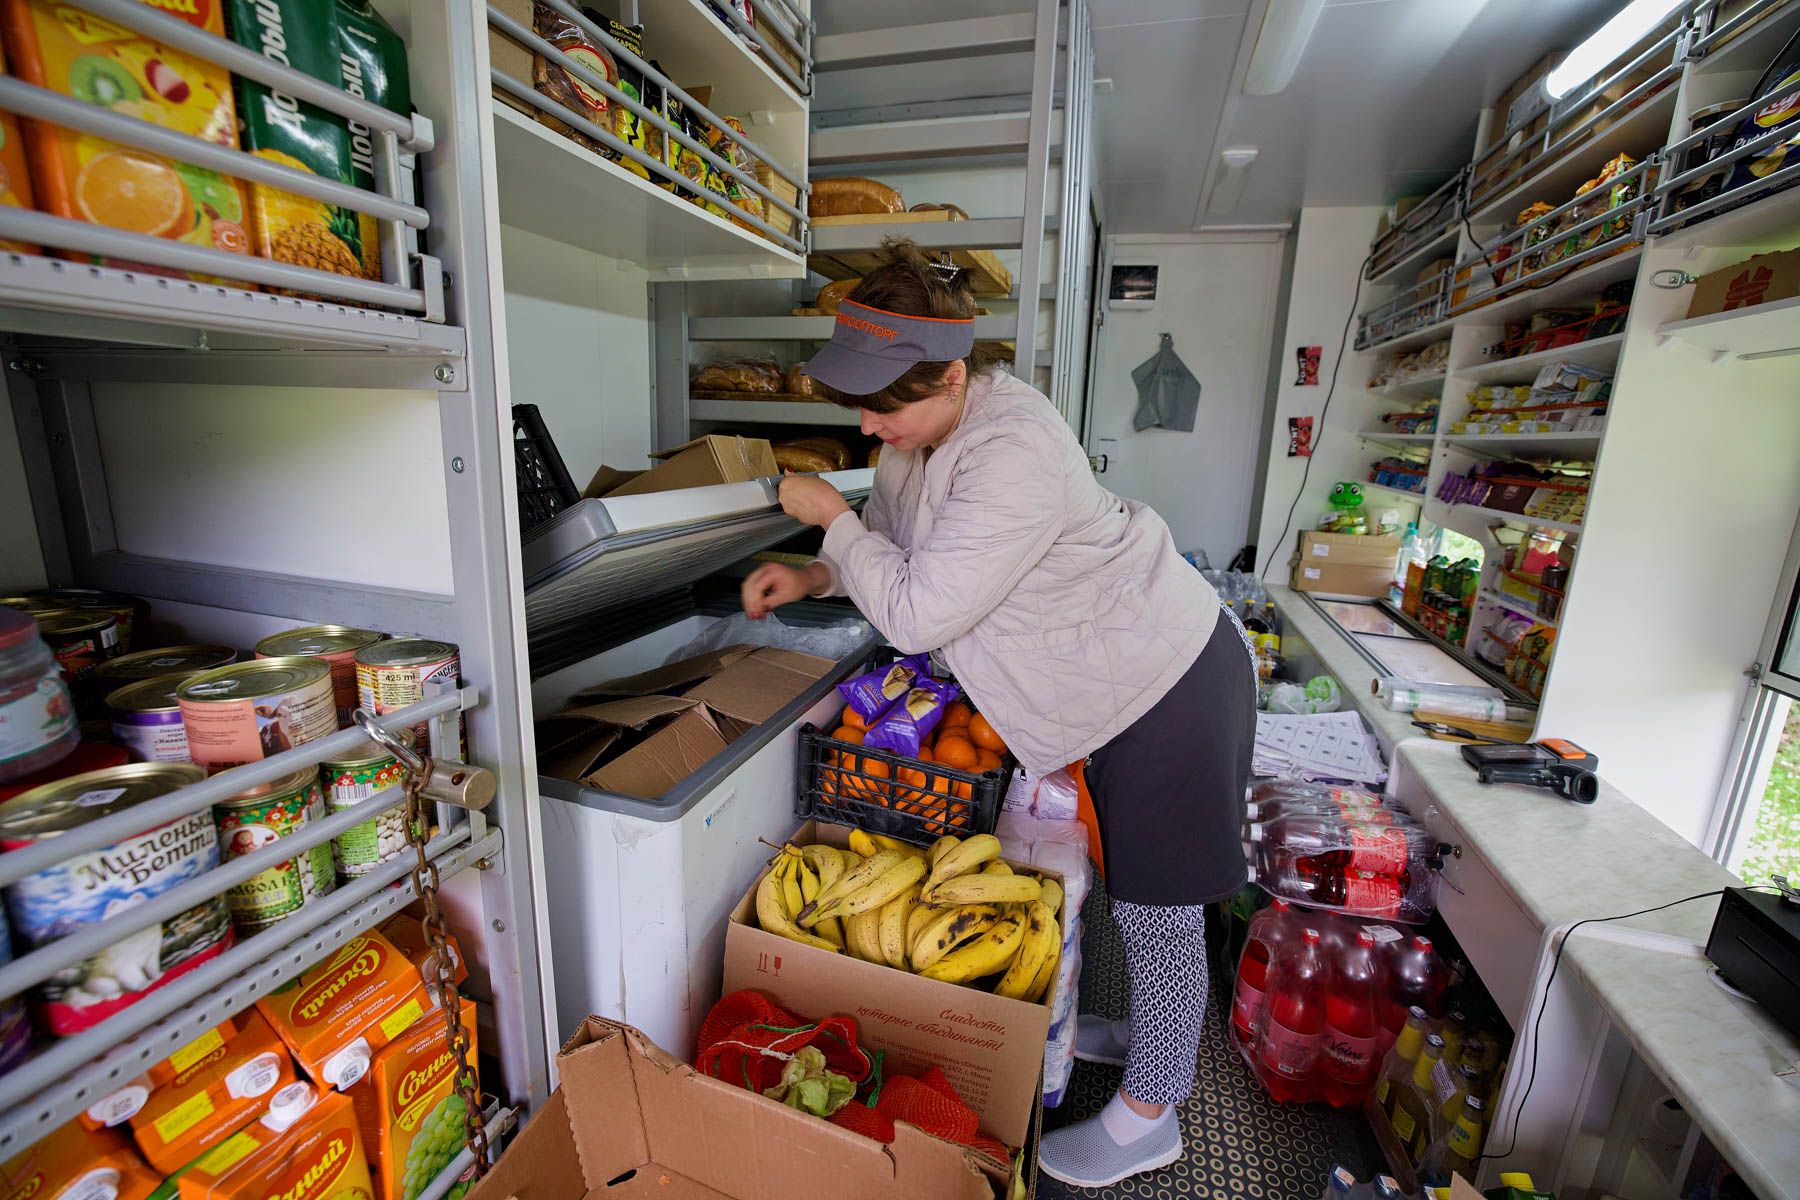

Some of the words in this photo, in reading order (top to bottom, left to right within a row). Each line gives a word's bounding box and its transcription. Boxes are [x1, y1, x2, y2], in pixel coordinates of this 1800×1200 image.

[385, 673, 401, 682] 425
[404, 672, 416, 681] ml
[856, 1006, 913, 1028] которые
[915, 1022, 1004, 1051] объединяют!
[939, 1009, 1006, 1036] Сладости,
